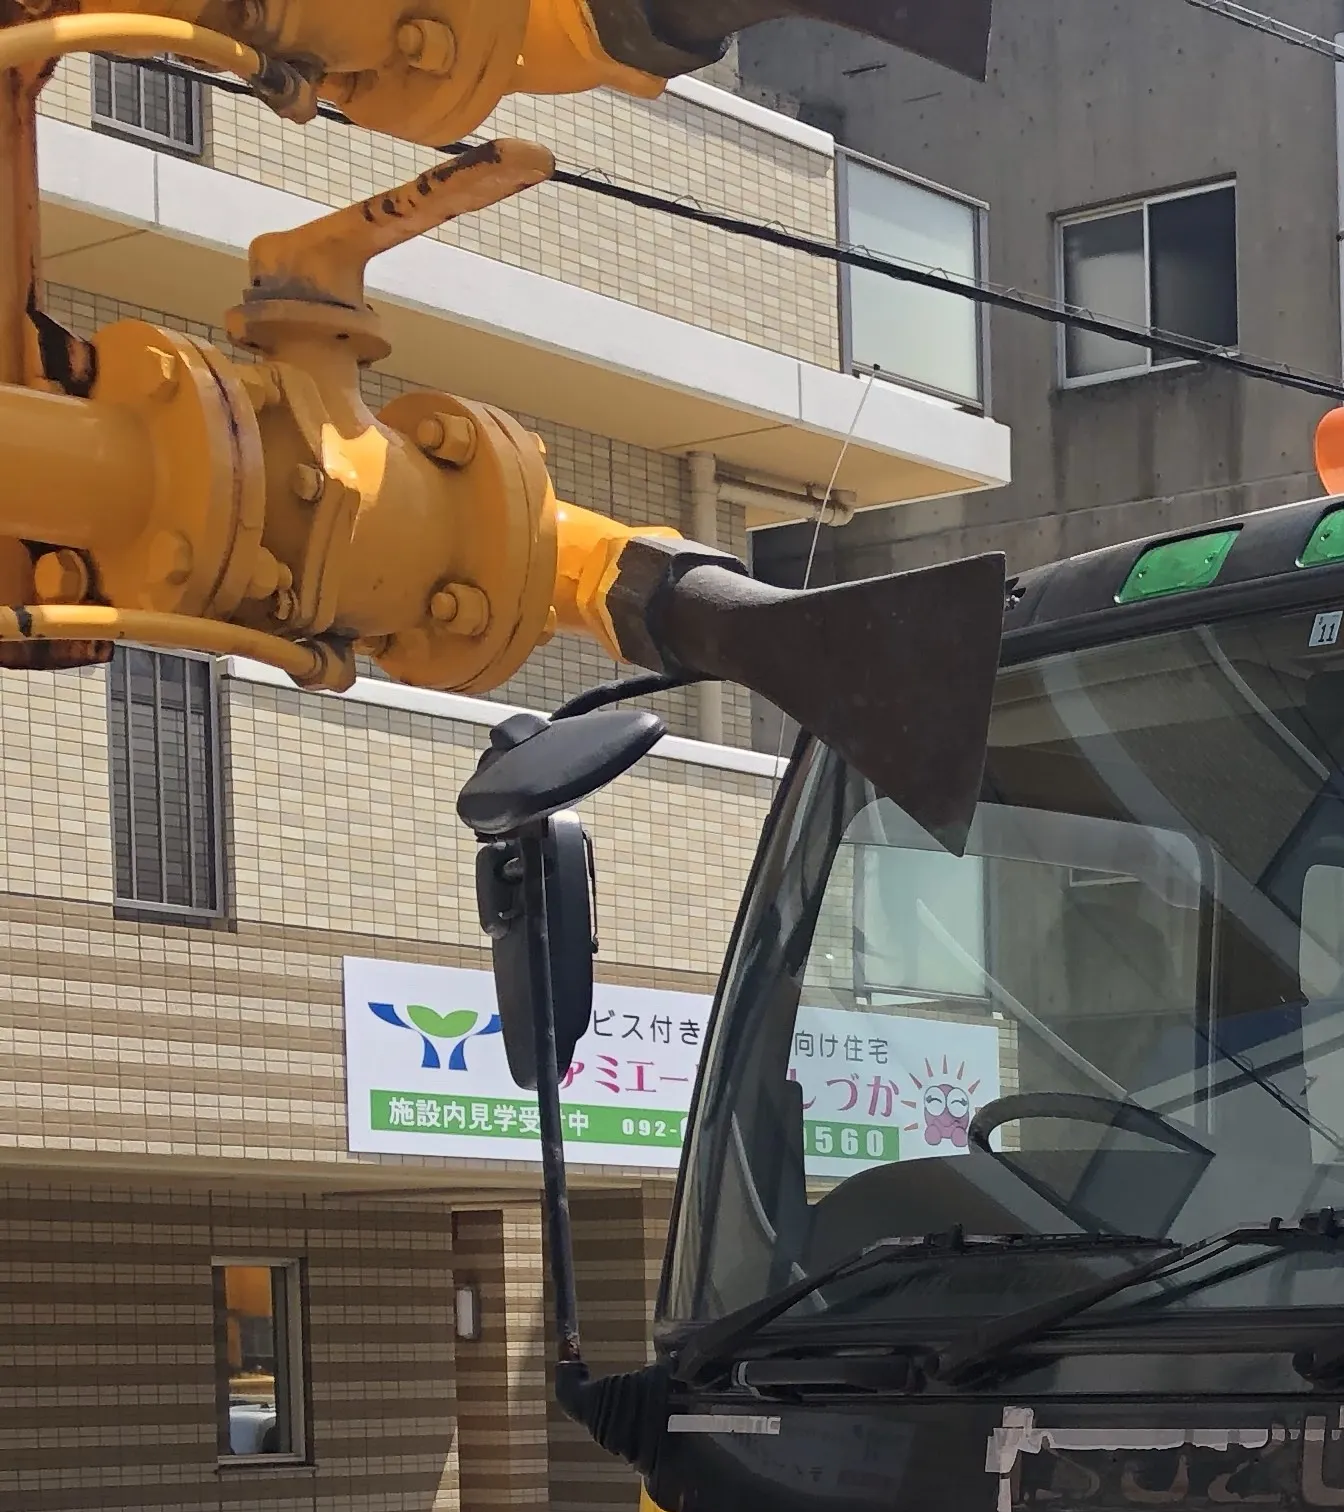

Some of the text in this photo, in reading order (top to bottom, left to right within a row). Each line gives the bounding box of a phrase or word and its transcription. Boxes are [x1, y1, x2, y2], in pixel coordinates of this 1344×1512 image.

[1318, 623, 1335, 642] 11
[622, 1117, 690, 1141] 092-
[801, 1125, 884, 1157] 560
